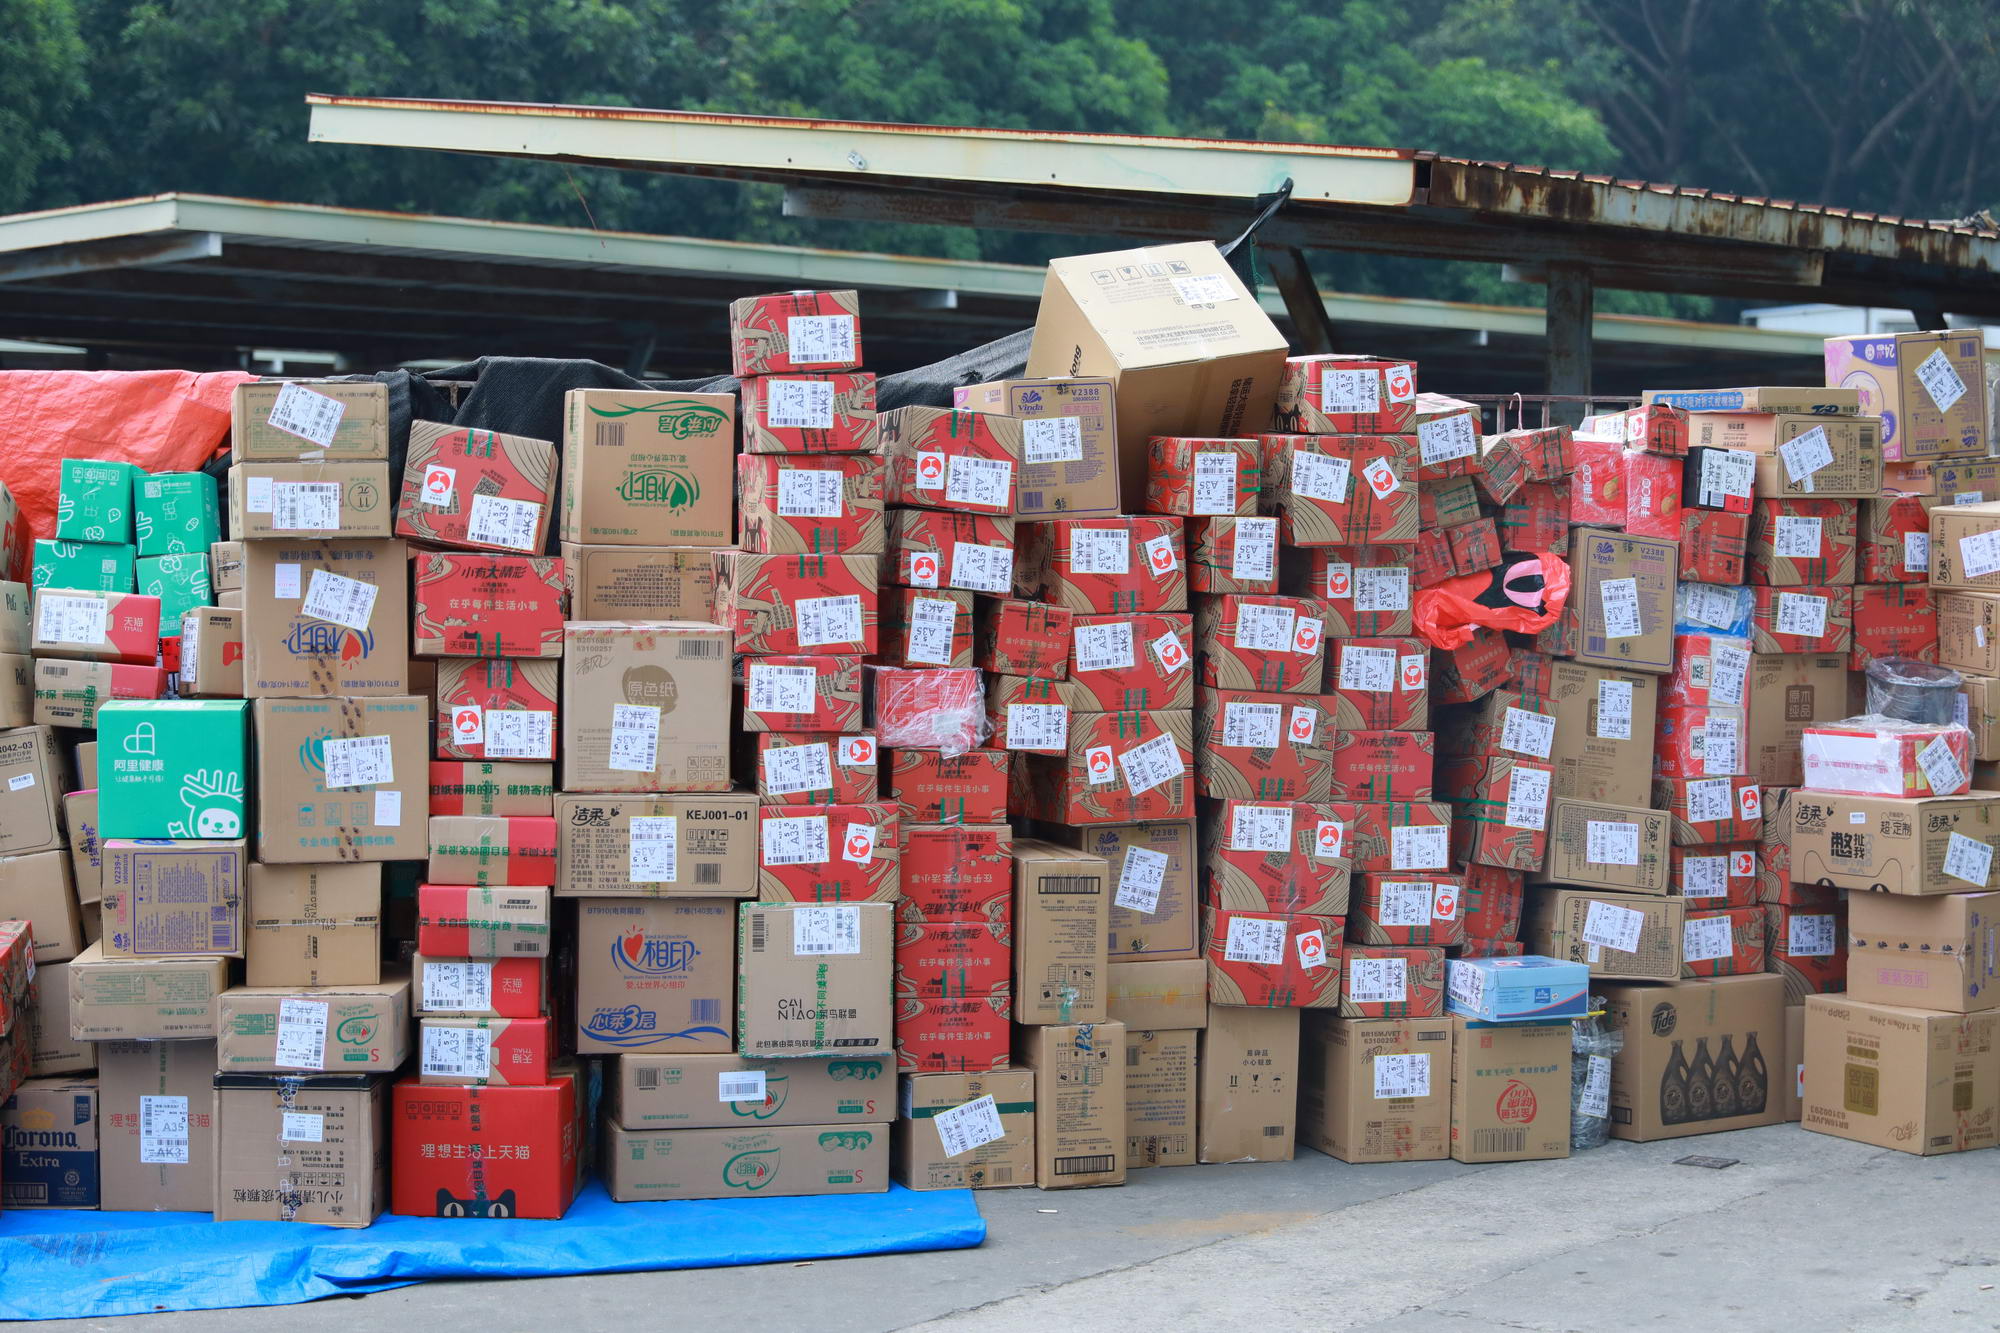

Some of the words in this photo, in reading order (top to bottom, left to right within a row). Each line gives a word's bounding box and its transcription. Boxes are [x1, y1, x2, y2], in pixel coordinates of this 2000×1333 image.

[815, 322, 824, 343] A35
[840, 321, 850, 349] AK3
[1069, 345, 1082, 377] long
[1345, 376, 1354, 395] A35
[1367, 378, 1376, 401] AK3
[795, 387, 804, 408] A35
[820, 389, 828, 416] AK3
[1441, 423, 1449, 443] A35
[1202, 457, 1225, 466] AK3
[804, 475, 813, 497] A35
[828, 478, 837, 504] AK3
[975, 477, 983, 499] A35
[1200, 480, 1218, 489] A35
[1314, 472, 1324, 492] A35
[1726, 471, 1735, 492] A35
[499, 505, 509, 527] A35
[522, 511, 534, 536] AK3
[1243, 522, 1265, 531] AK3
[1075, 541, 1084, 565] AK3
[1098, 548, 1106, 568] A35
[1240, 545, 1258, 554] A35
[976, 551, 986, 573] A35
[1359, 581, 1367, 605] AK3
[1379, 586, 1387, 606] A35
[123, 616, 144, 626] 天猫
[1608, 606, 1623, 615] A35
[802, 612, 813, 640] AK3
[827, 616, 837, 639] A35
[916, 627, 936, 636] A35
[1240, 617, 1249, 640] AK3
[1262, 625, 1270, 648] A35
[1099, 629, 1107, 650] A35
[1120, 629, 1129, 653] AK3
[1345, 659, 1354, 682] AK3
[1365, 666, 1373, 686] A35
[626, 681, 674, 697] 原色纸
[780, 685, 789, 706] A35
[512, 716, 520, 737] A35
[1032, 707, 1040, 728] A35
[616, 736, 638, 745] A35
[1227, 717, 1237, 743] AK3
[113, 759, 164, 772] 阿里健康
[790, 751, 801, 772] A35
[815, 750, 825, 775] AK3
[1150, 761, 1162, 779] A35
[1524, 793, 1543, 802] A35
[1689, 792, 1697, 816] AK3
[571, 805, 604, 822] 洁柔
[687, 810, 748, 821] KEJ001-01
[1796, 804, 1821, 820] 洁柔
[791, 824, 799, 844] A35
[815, 824, 824, 849] AK3
[1260, 825, 1268, 845] A35
[1139, 874, 1158, 884] A35
[1700, 862, 1708, 880] A35
[820, 912, 829, 934] A35
[1251, 925, 1260, 945] A35
[450, 968, 459, 989] A35
[503, 978, 522, 988] 天猫
[1372, 962, 1380, 983] A35
[1394, 964, 1402, 988] AK3
[778, 999, 802, 1009] CAI
[588, 1005, 656, 1034] 心柔3层
[1653, 1011, 1674, 1034] Tide
[450, 1033, 459, 1054] A35
[474, 1036, 485, 1060] AK3
[371, 1049, 379, 1062] S
[866, 1100, 875, 1114] S
[4, 1125, 77, 1148] Corona
[163, 1122, 184, 1132] A35
[20, 1153, 60, 1167] Extra
[421, 1144, 530, 1160] 理想生活上天猫
[855, 1170, 863, 1183] S
